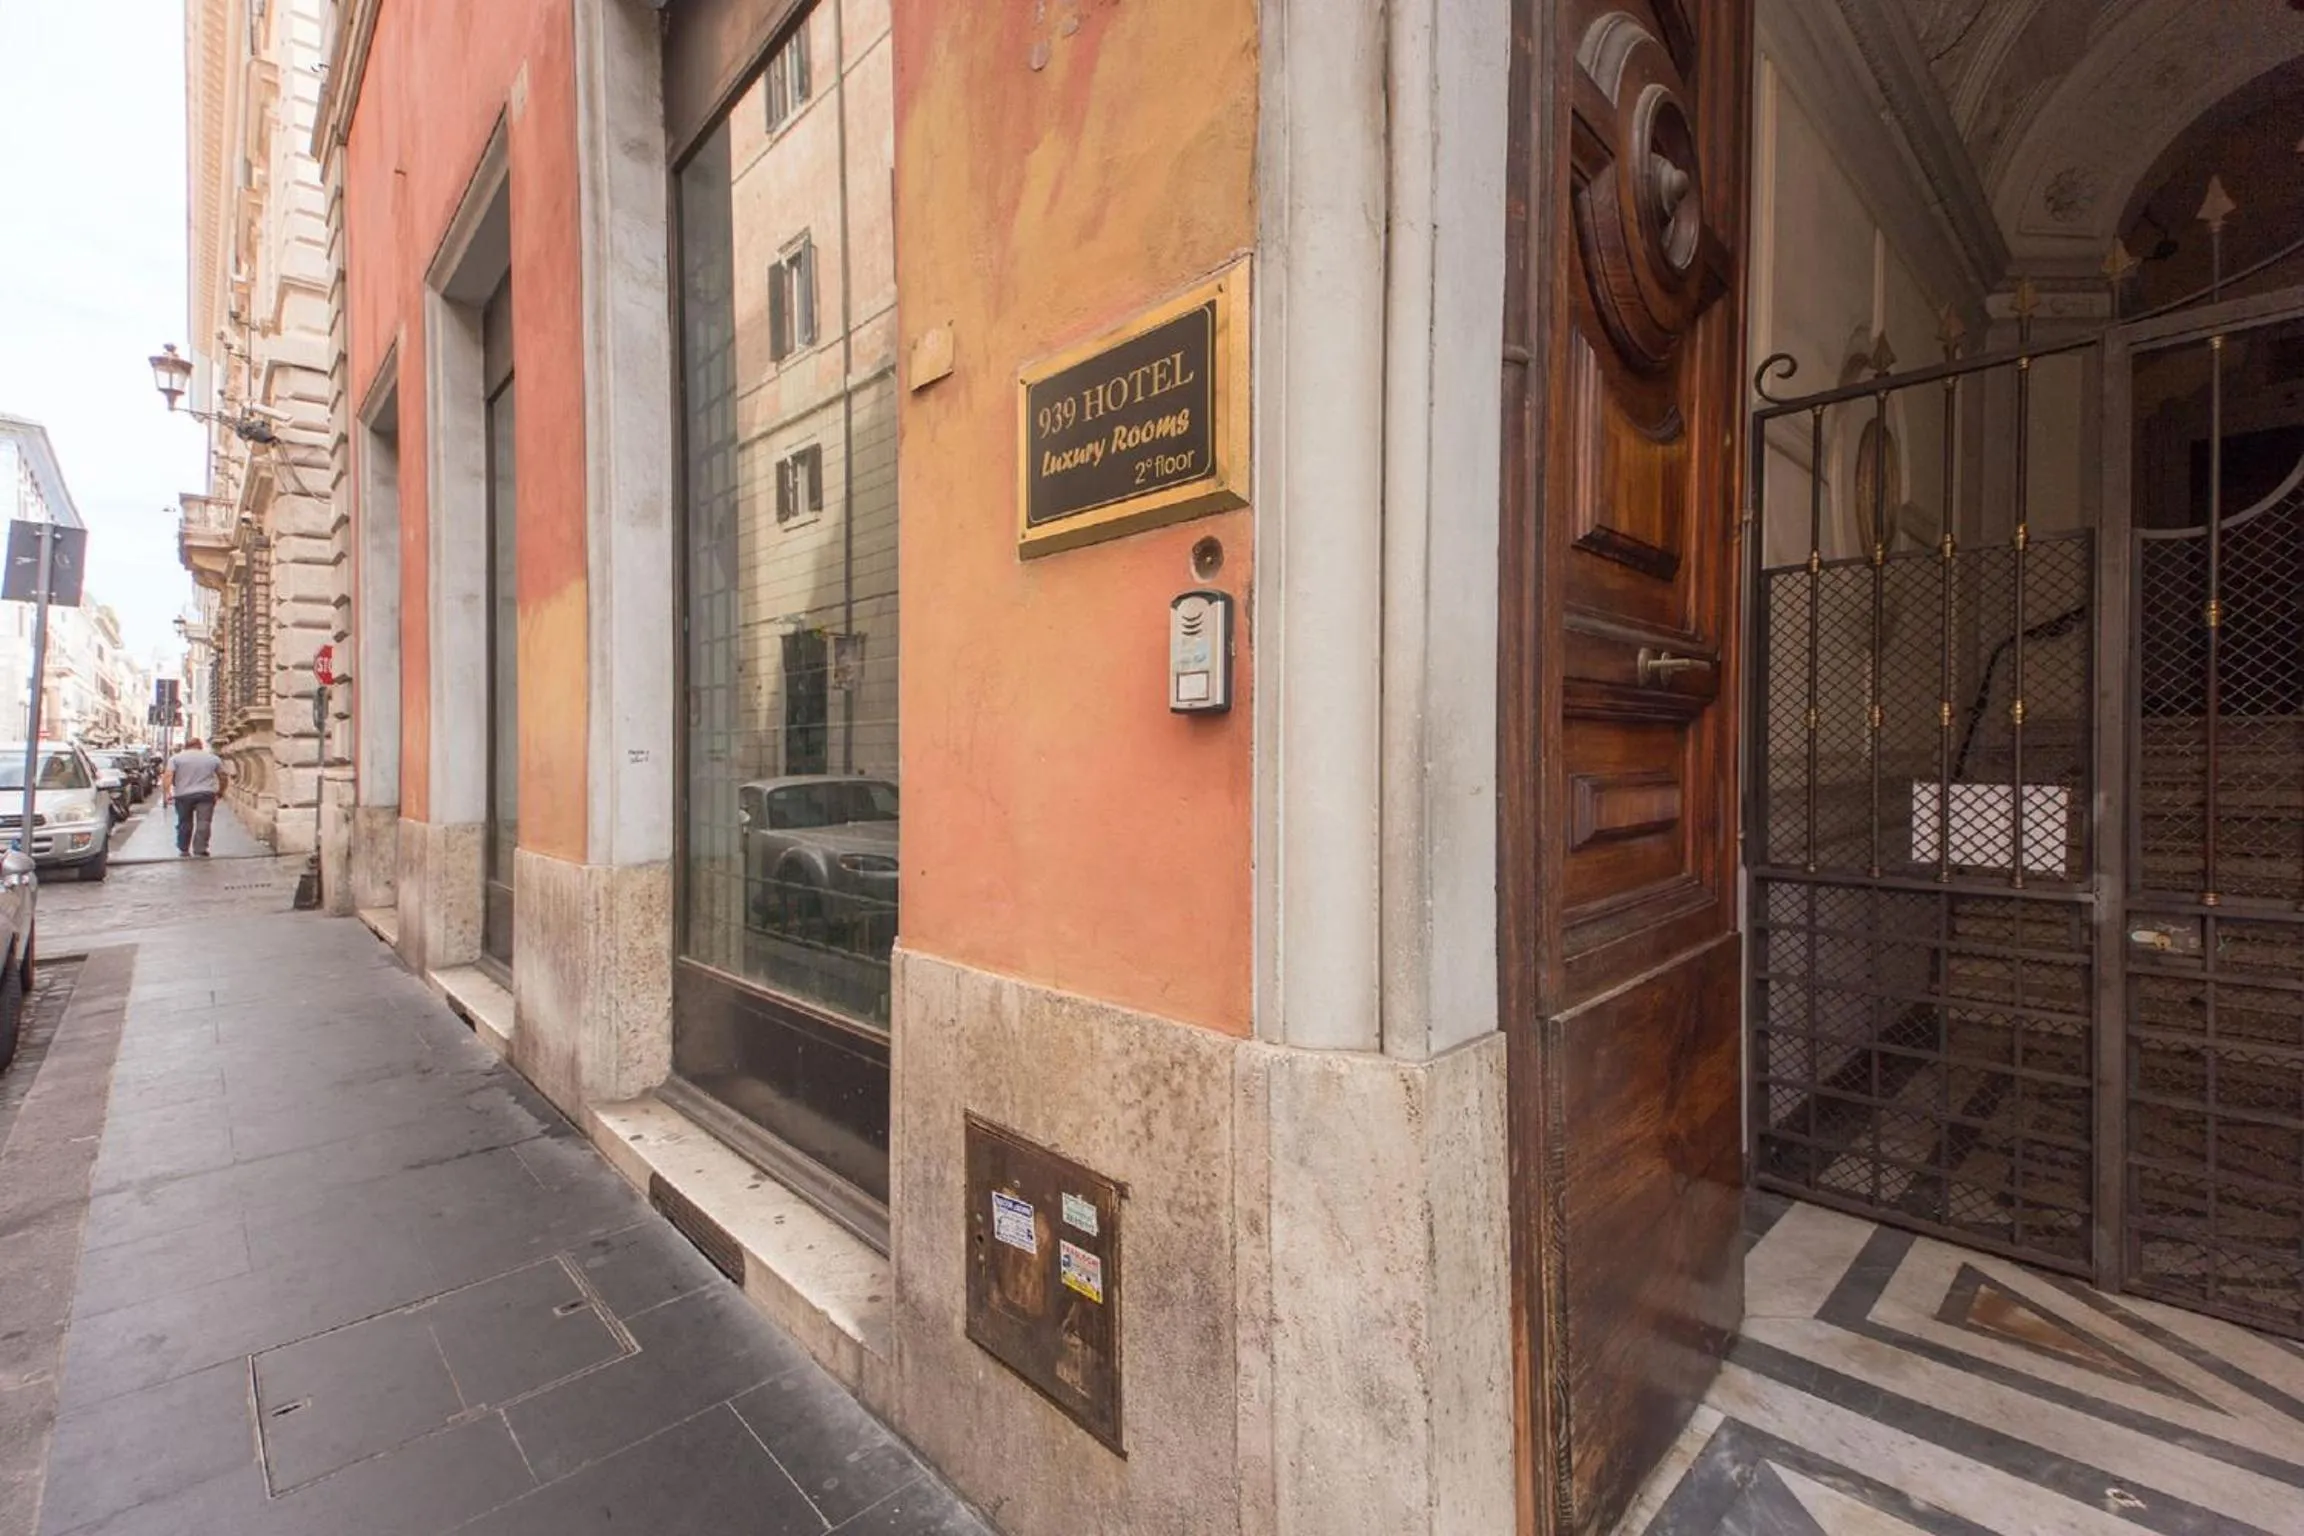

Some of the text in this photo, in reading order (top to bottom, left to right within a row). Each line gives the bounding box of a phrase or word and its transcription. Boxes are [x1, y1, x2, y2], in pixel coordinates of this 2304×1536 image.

[1039, 350, 1195, 439] 939 HOTEL
[1041, 407, 1191, 477] Luxury Rooms
[1155, 450, 1195, 478] floor
